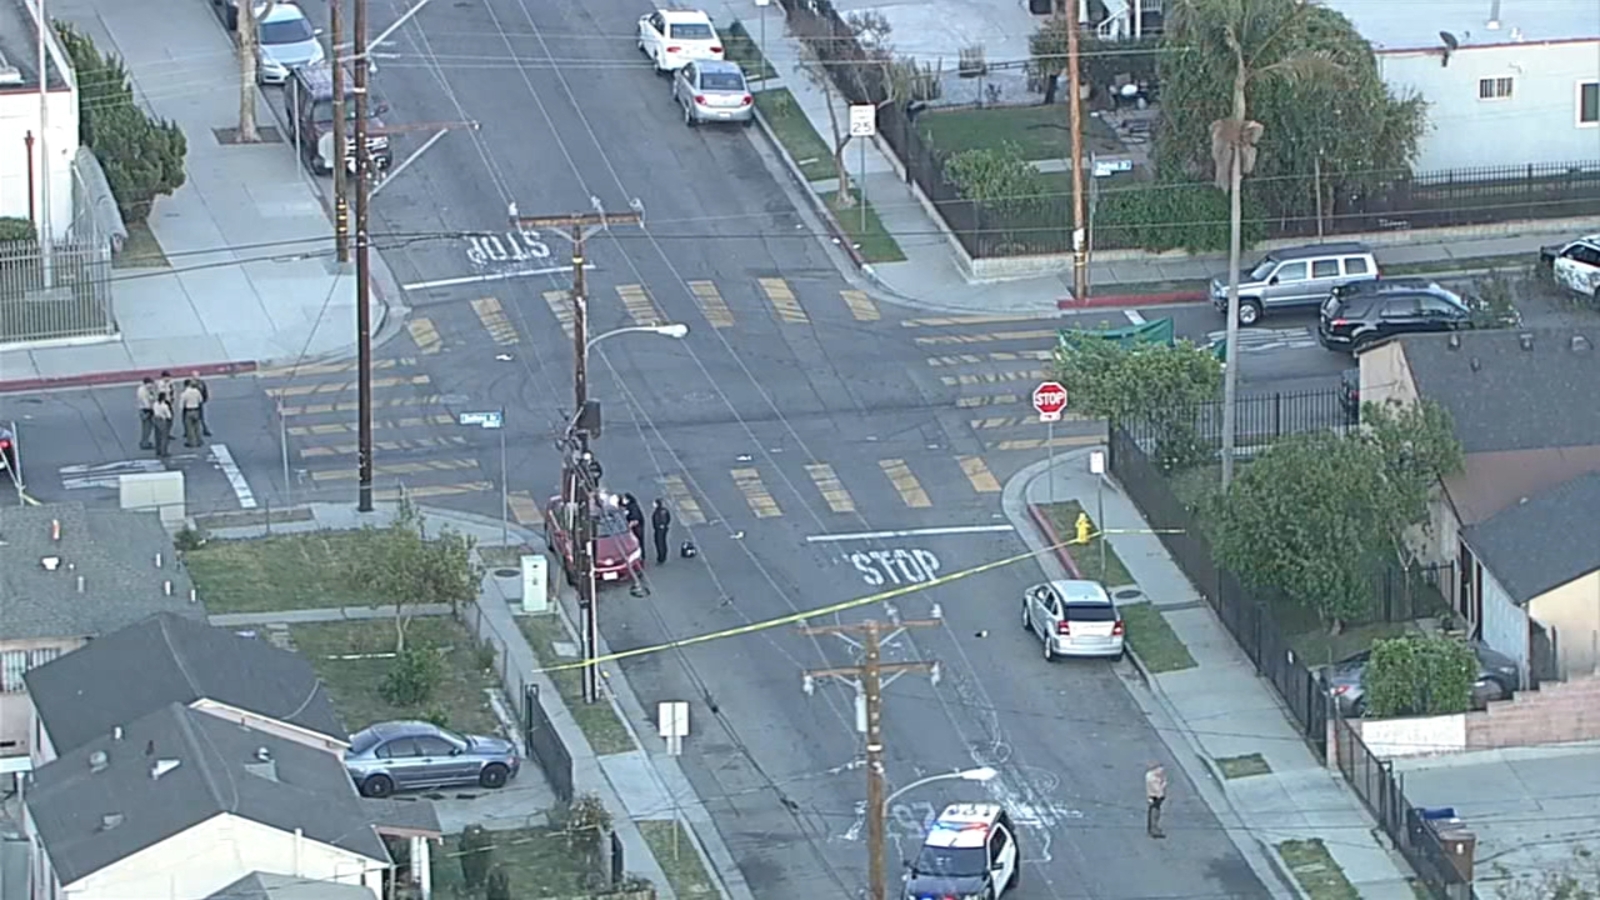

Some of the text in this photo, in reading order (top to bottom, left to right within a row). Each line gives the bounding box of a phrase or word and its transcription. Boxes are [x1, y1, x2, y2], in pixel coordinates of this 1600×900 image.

[853, 121, 872, 133] 25
[466, 230, 550, 265] STOP
[1036, 392, 1065, 406] STOP
[850, 548, 941, 586] STOP
